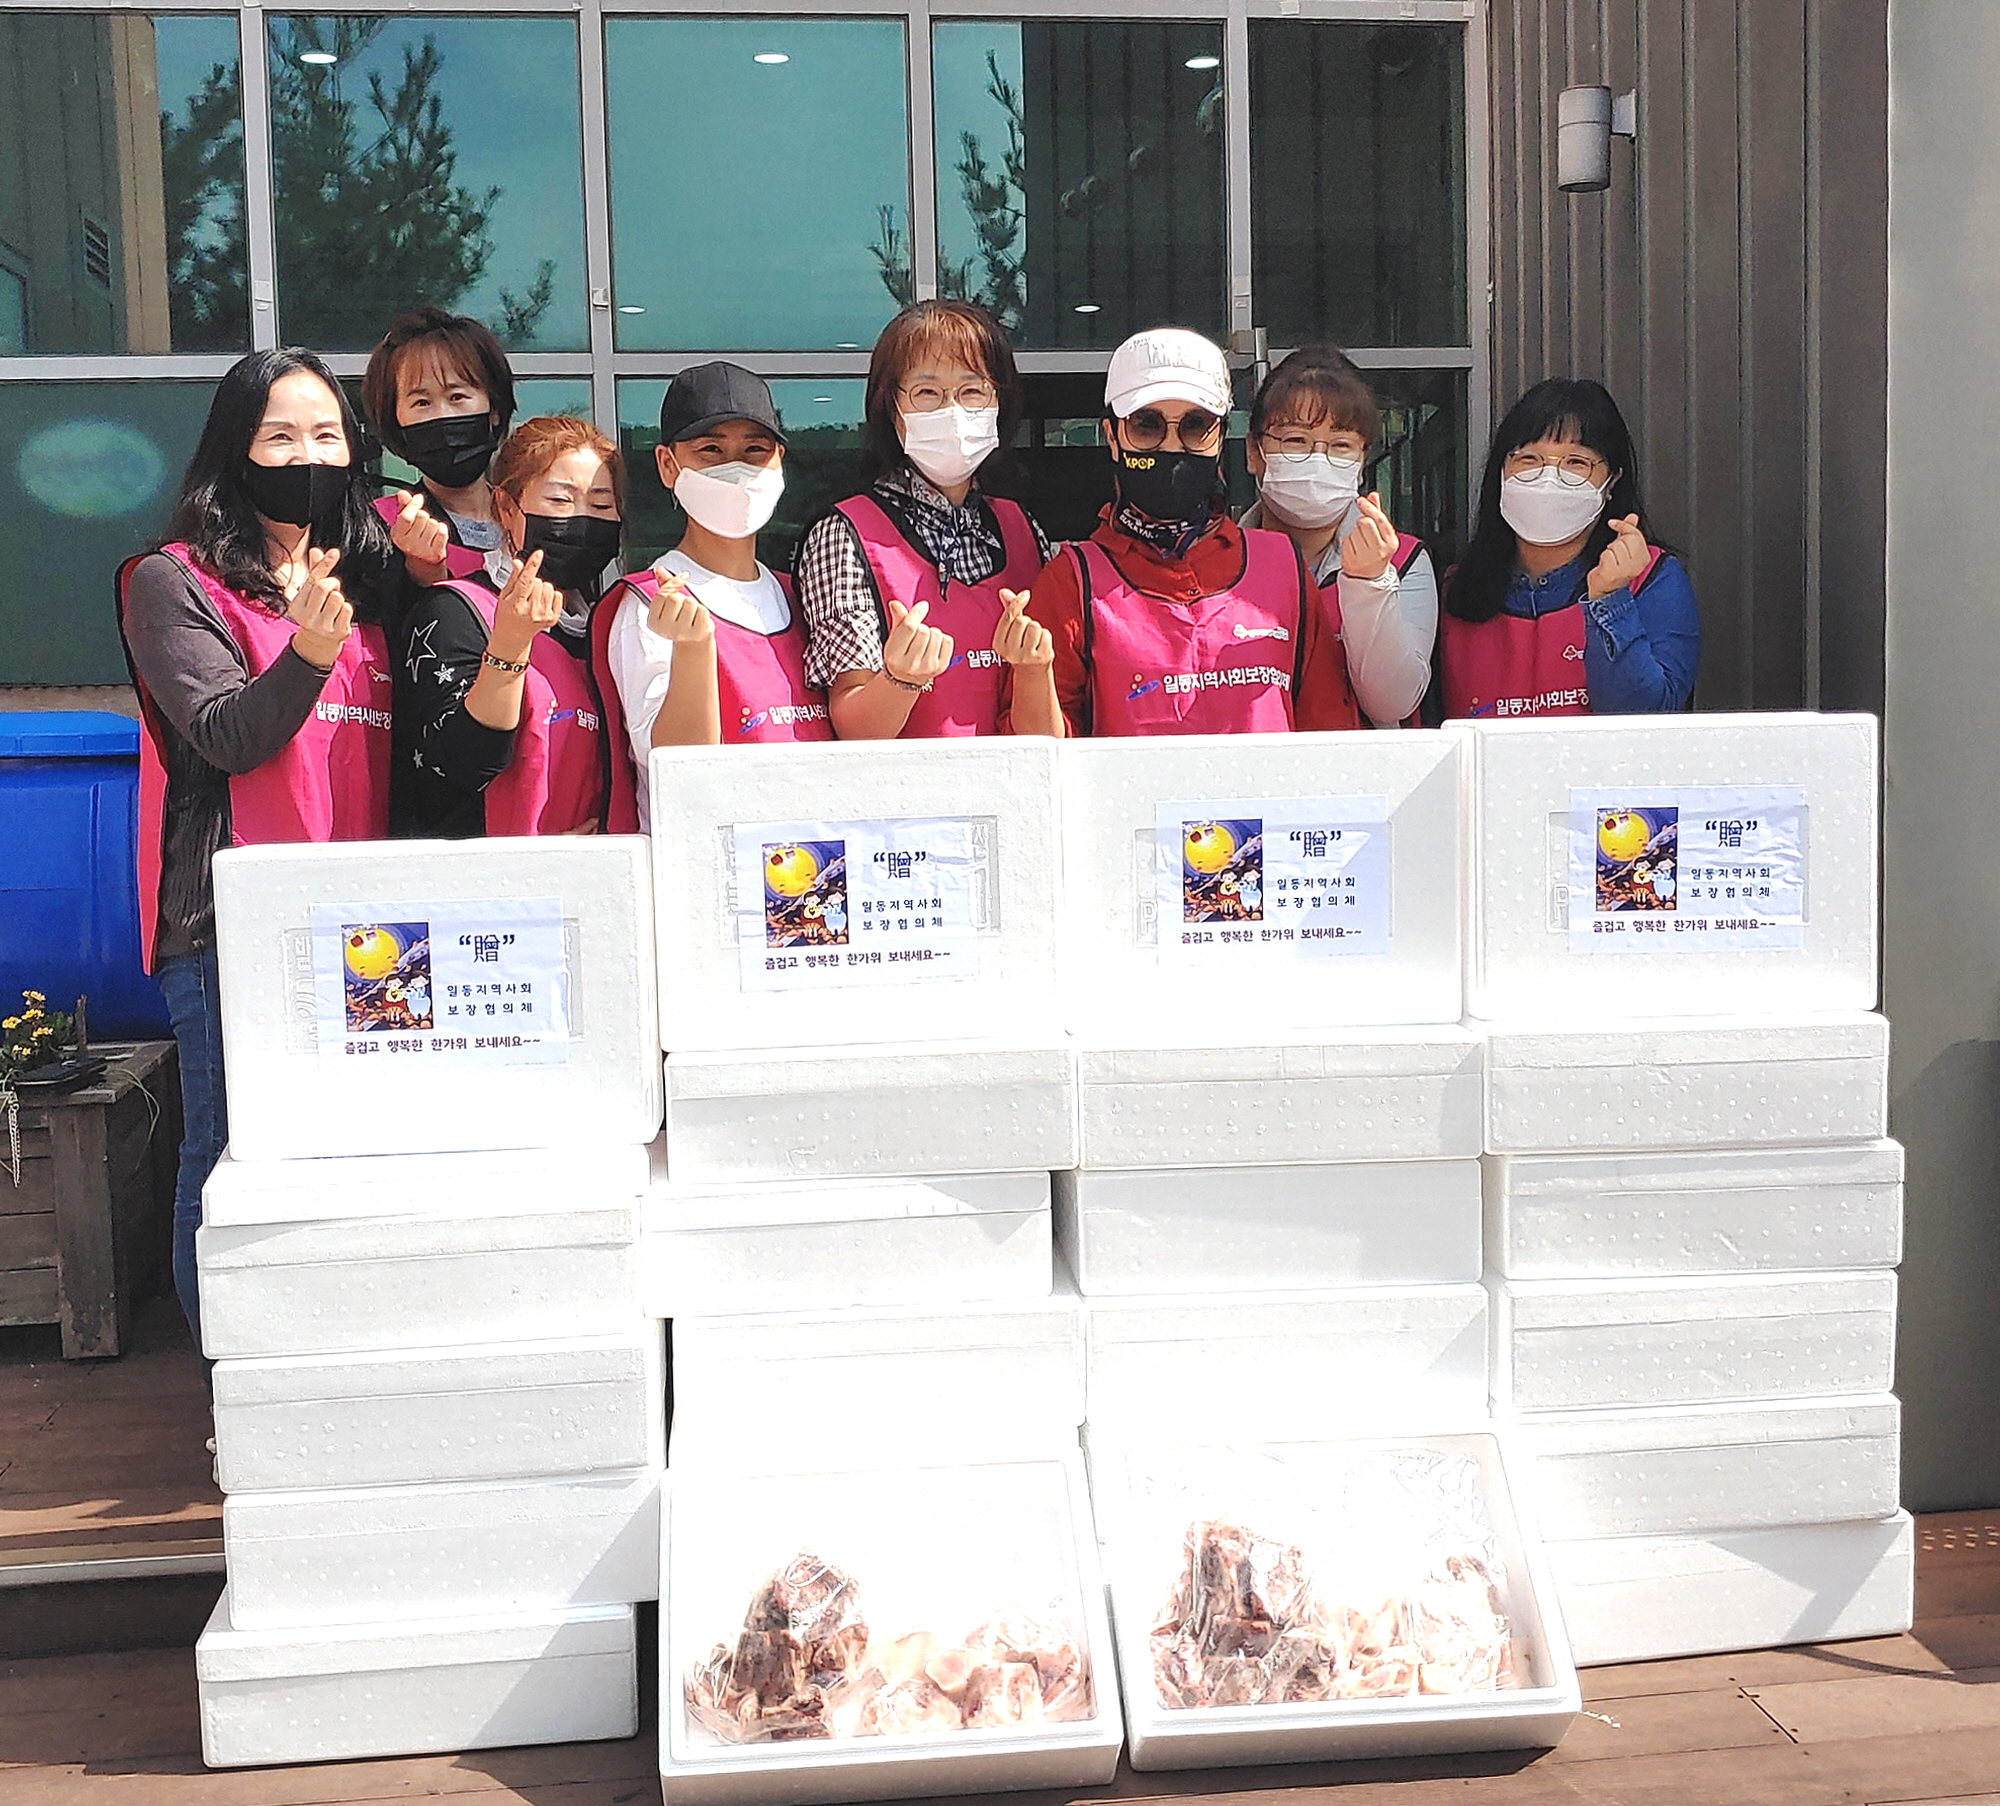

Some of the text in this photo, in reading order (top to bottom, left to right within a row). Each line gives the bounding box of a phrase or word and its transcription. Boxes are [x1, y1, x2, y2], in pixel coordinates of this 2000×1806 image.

[1123, 452, 1156, 469] KPOP
[1592, 920, 1626, 934] 즐겁고
[1632, 919, 1667, 933] 행복한
[1673, 919, 1708, 933] 한가위
[1181, 931, 1214, 945] 즐겁고
[1219, 930, 1254, 944] 행복한
[1260, 928, 1295, 942] 한가위
[764, 956, 799, 971] 즐겁고
[804, 954, 840, 969] 행복한
[846, 952, 882, 966] 한가위
[344, 1041, 381, 1056] 즐겁고
[386, 1038, 424, 1054] 행복한
[430, 1037, 468, 1052] 한가위
